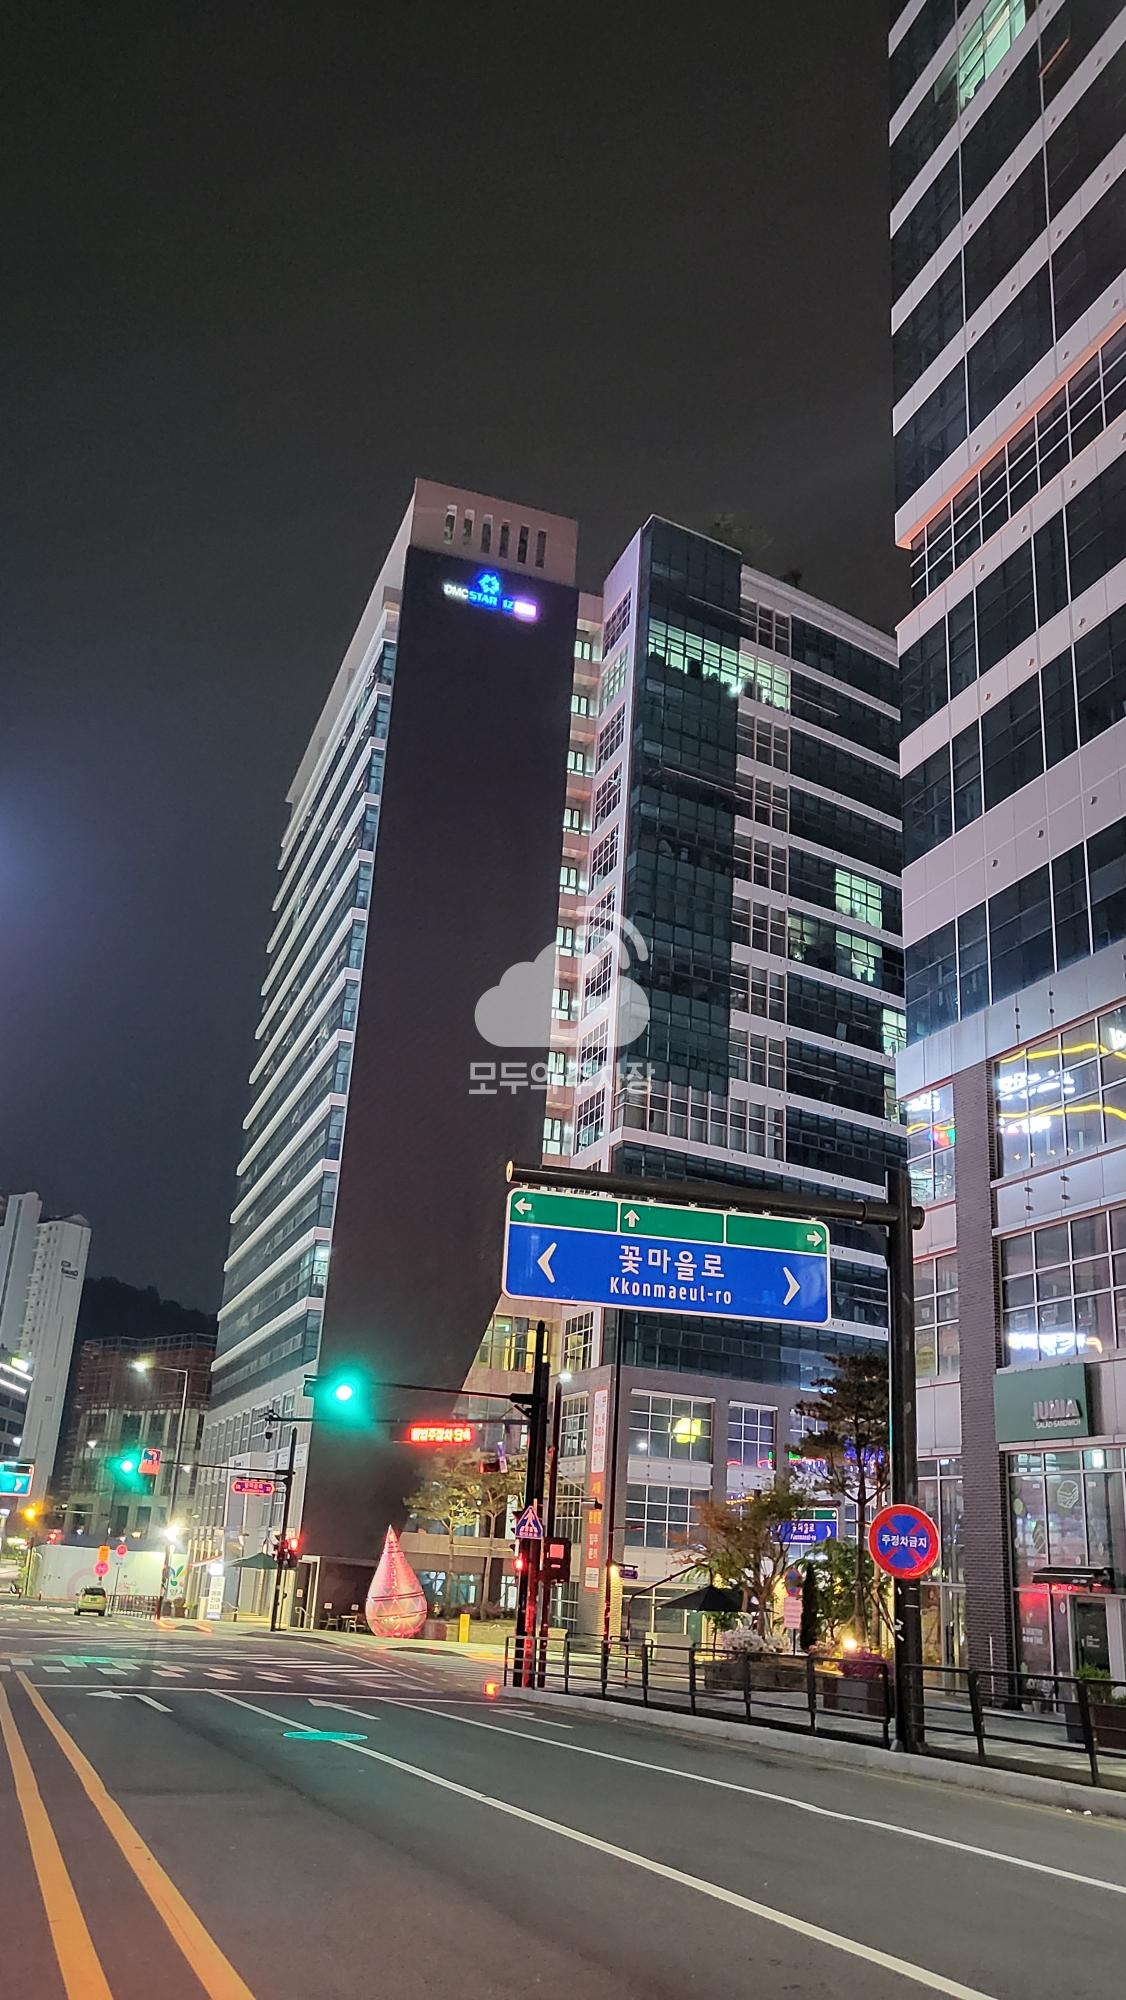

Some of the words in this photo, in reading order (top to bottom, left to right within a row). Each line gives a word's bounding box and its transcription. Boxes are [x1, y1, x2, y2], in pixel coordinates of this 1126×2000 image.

[443, 584, 468, 599] DMC
[469, 591, 498, 605] STAR
[618, 1244, 725, 1282] 꽃마을로
[609, 1275, 732, 1305] Kkonmaeul-ro
[881, 1534, 927, 1549] 주정차금지
